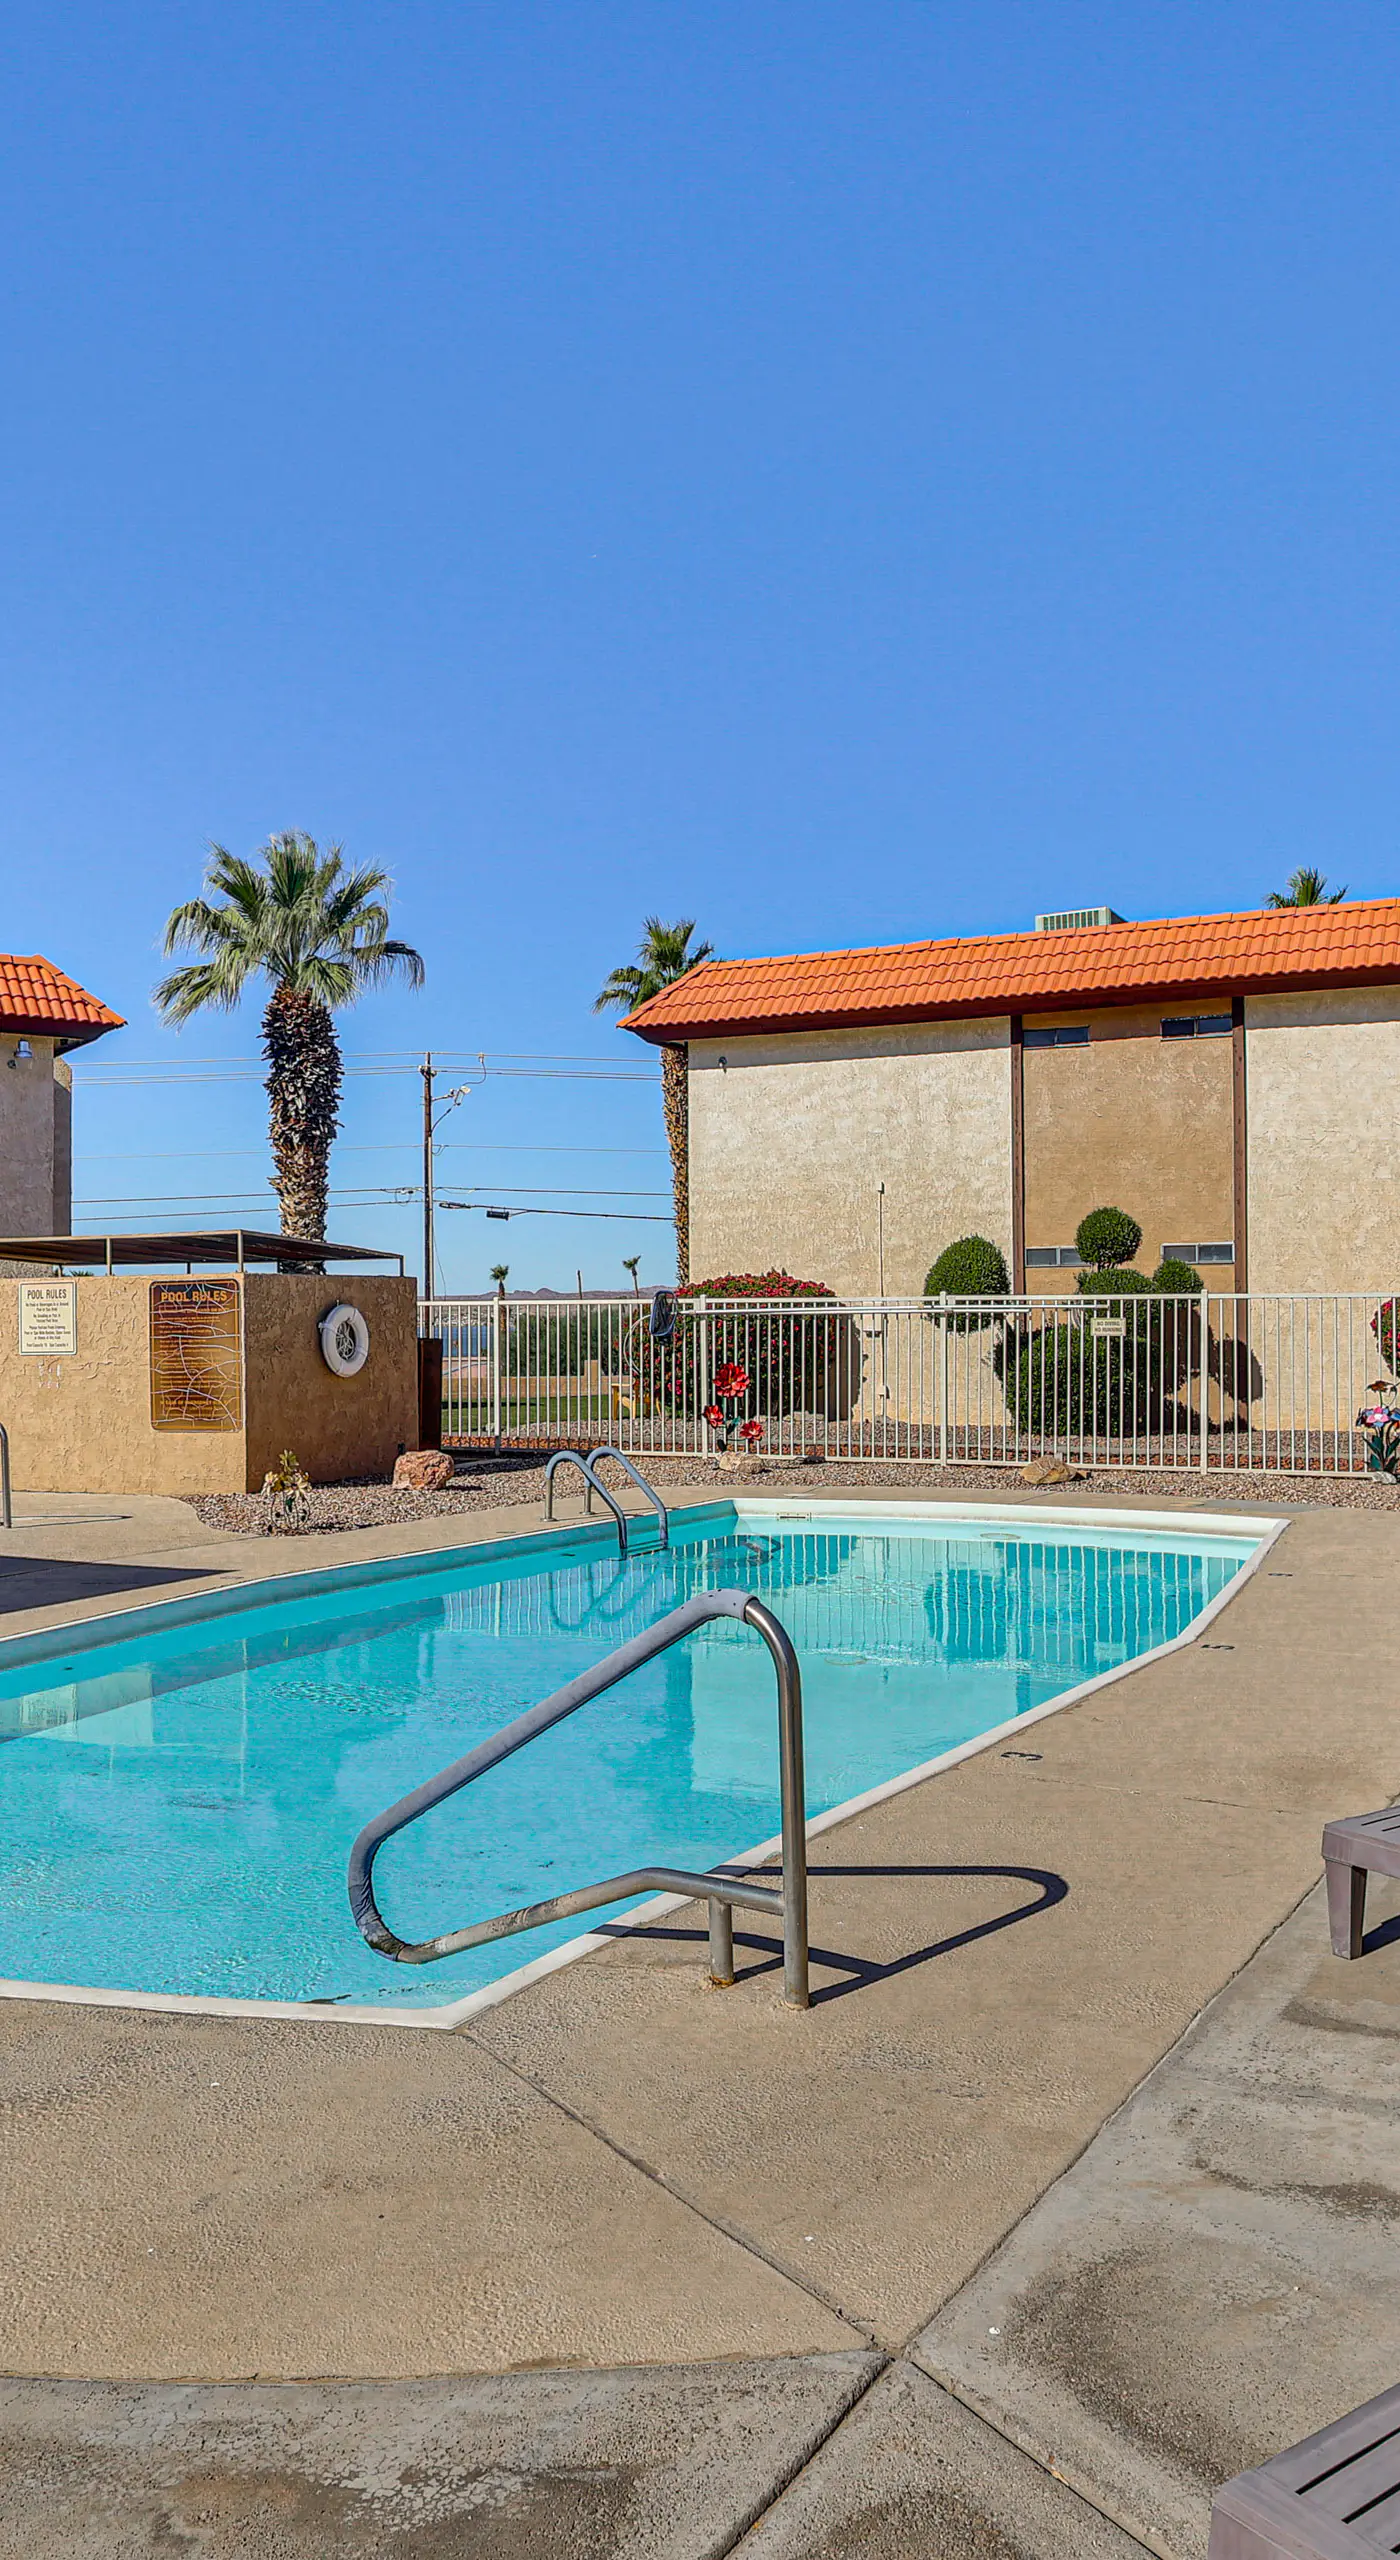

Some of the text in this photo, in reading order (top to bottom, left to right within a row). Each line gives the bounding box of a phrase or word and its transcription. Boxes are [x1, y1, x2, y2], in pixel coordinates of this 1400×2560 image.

[27, 1288, 67, 1300] POOL RULES
[161, 1290, 228, 1302] POOL RULES
[1000, 1751, 1043, 1761] 3
